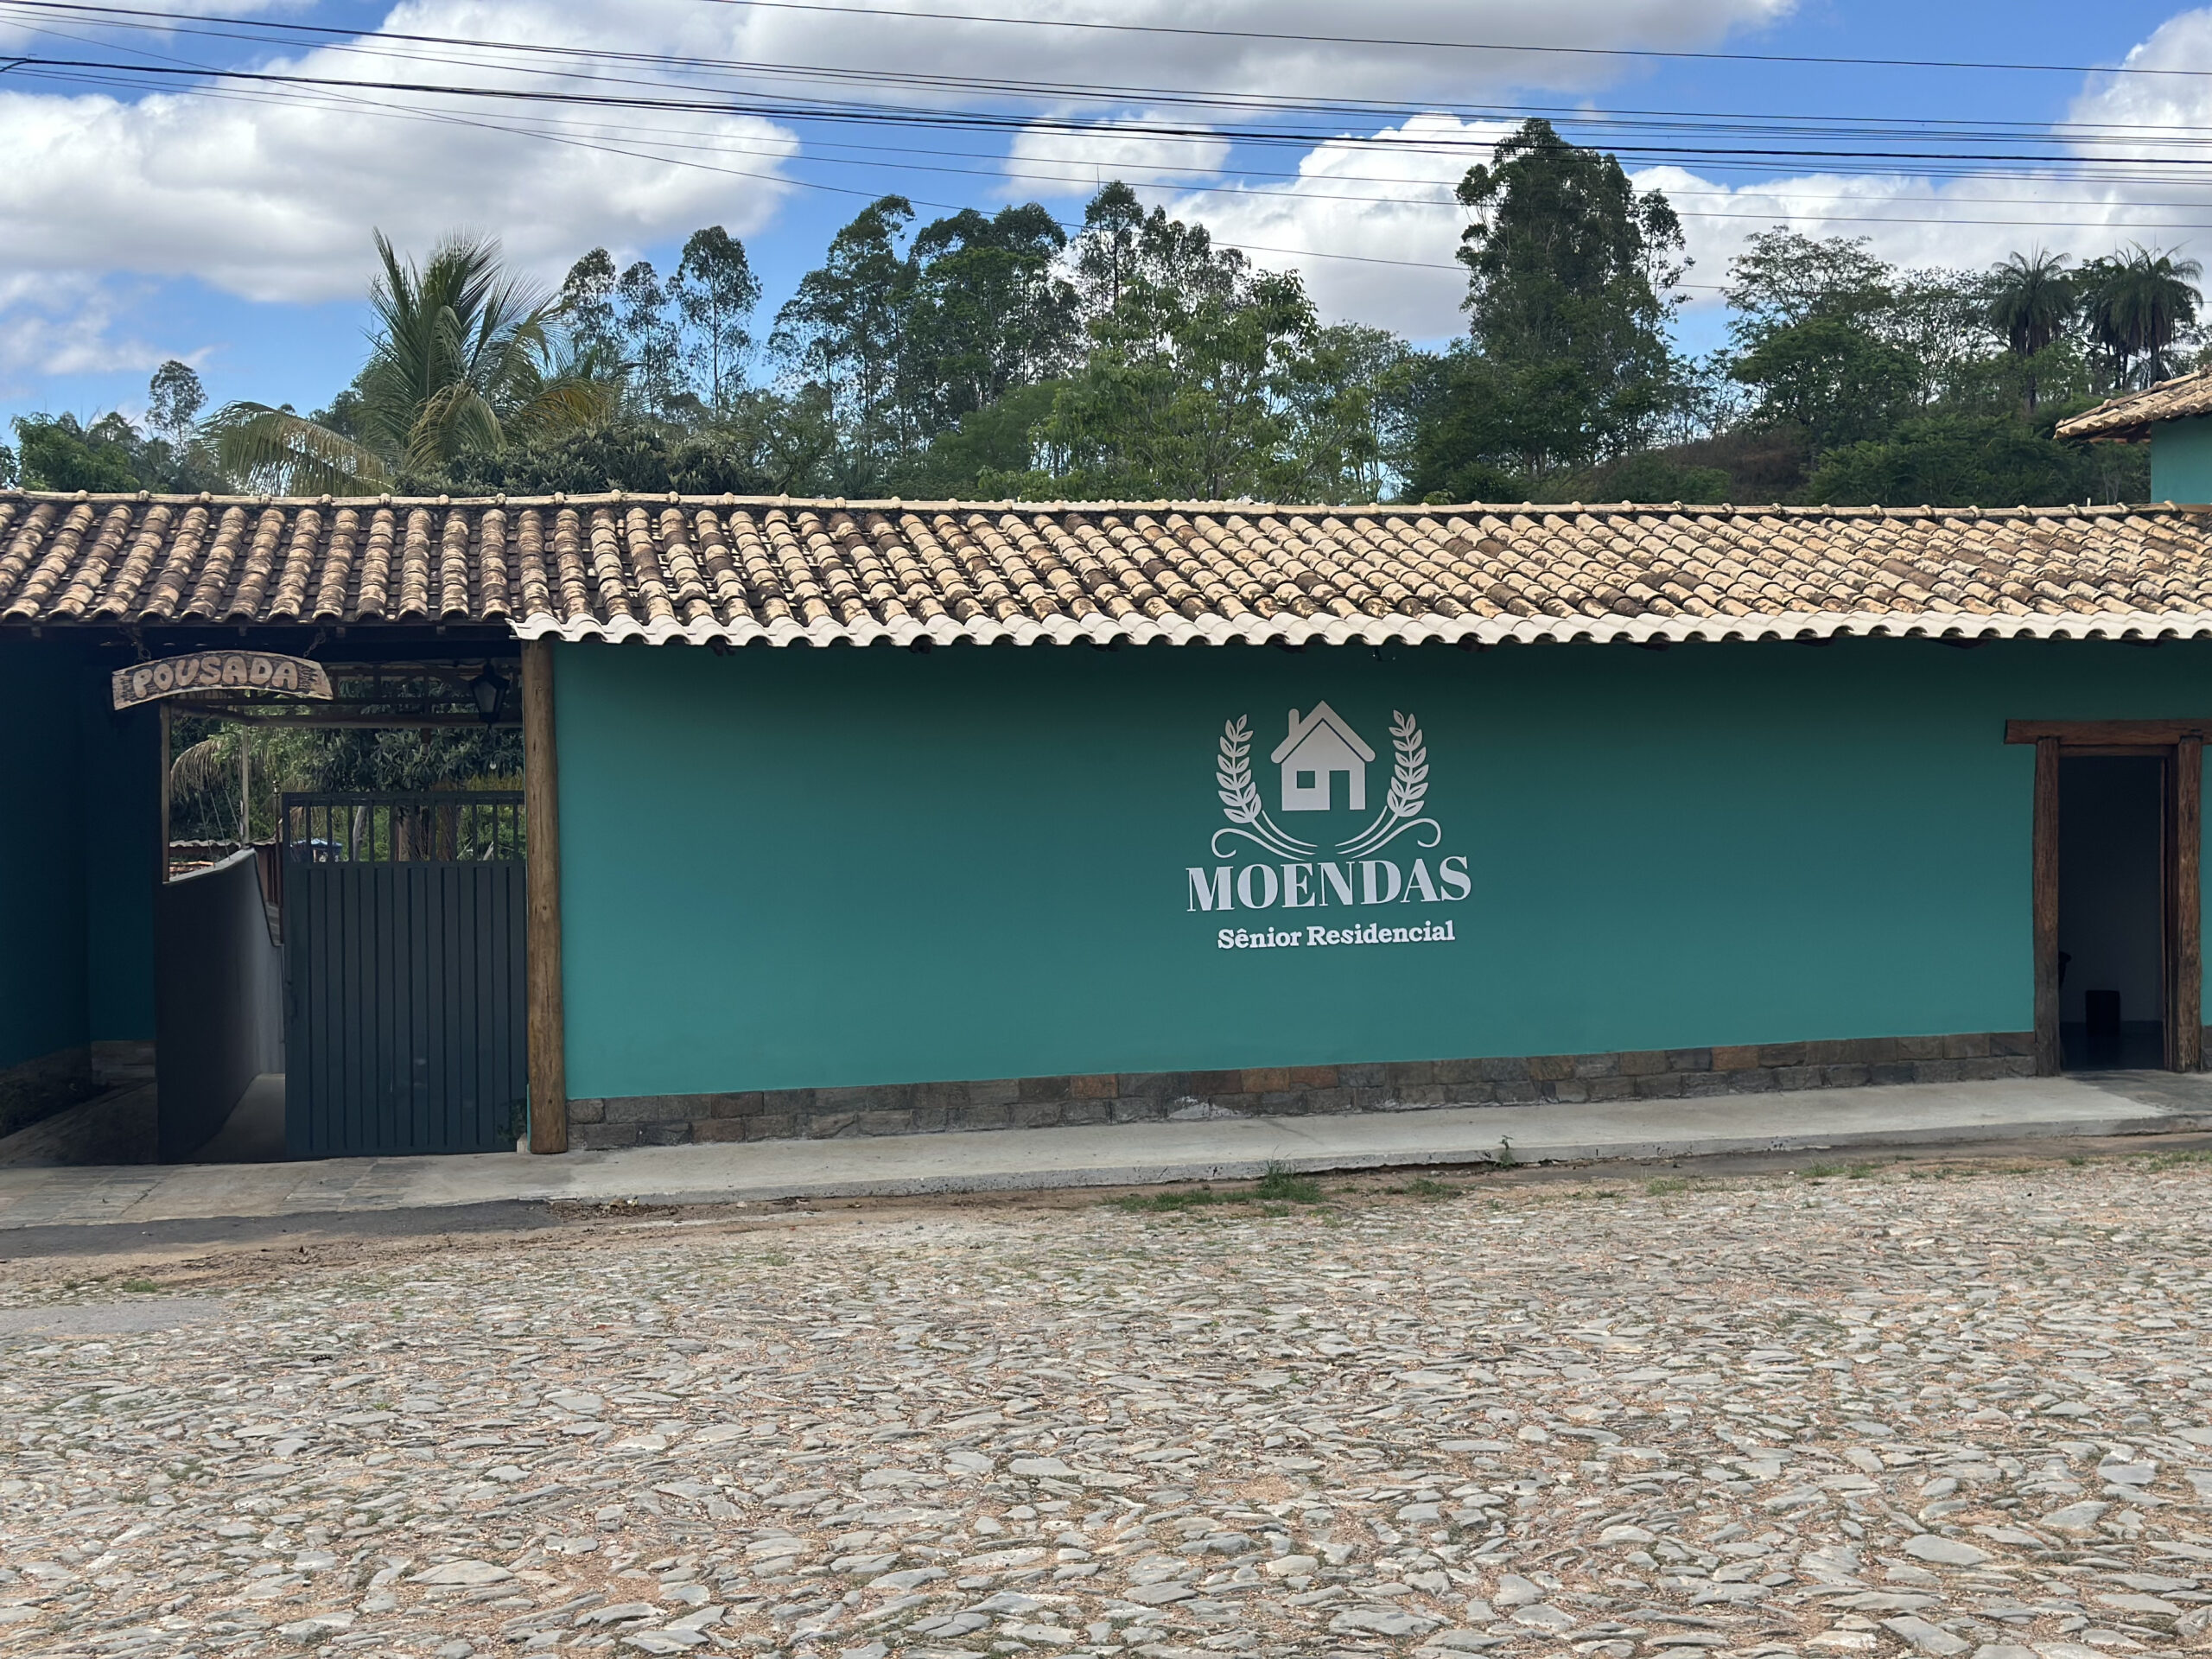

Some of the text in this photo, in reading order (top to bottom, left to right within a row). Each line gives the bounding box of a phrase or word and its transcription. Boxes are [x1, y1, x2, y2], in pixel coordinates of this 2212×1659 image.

[132, 655, 299, 698] POUSADA
[1185, 855, 1471, 912] MOENDAS
[1217, 919, 1456, 950] Sênior Residencial
